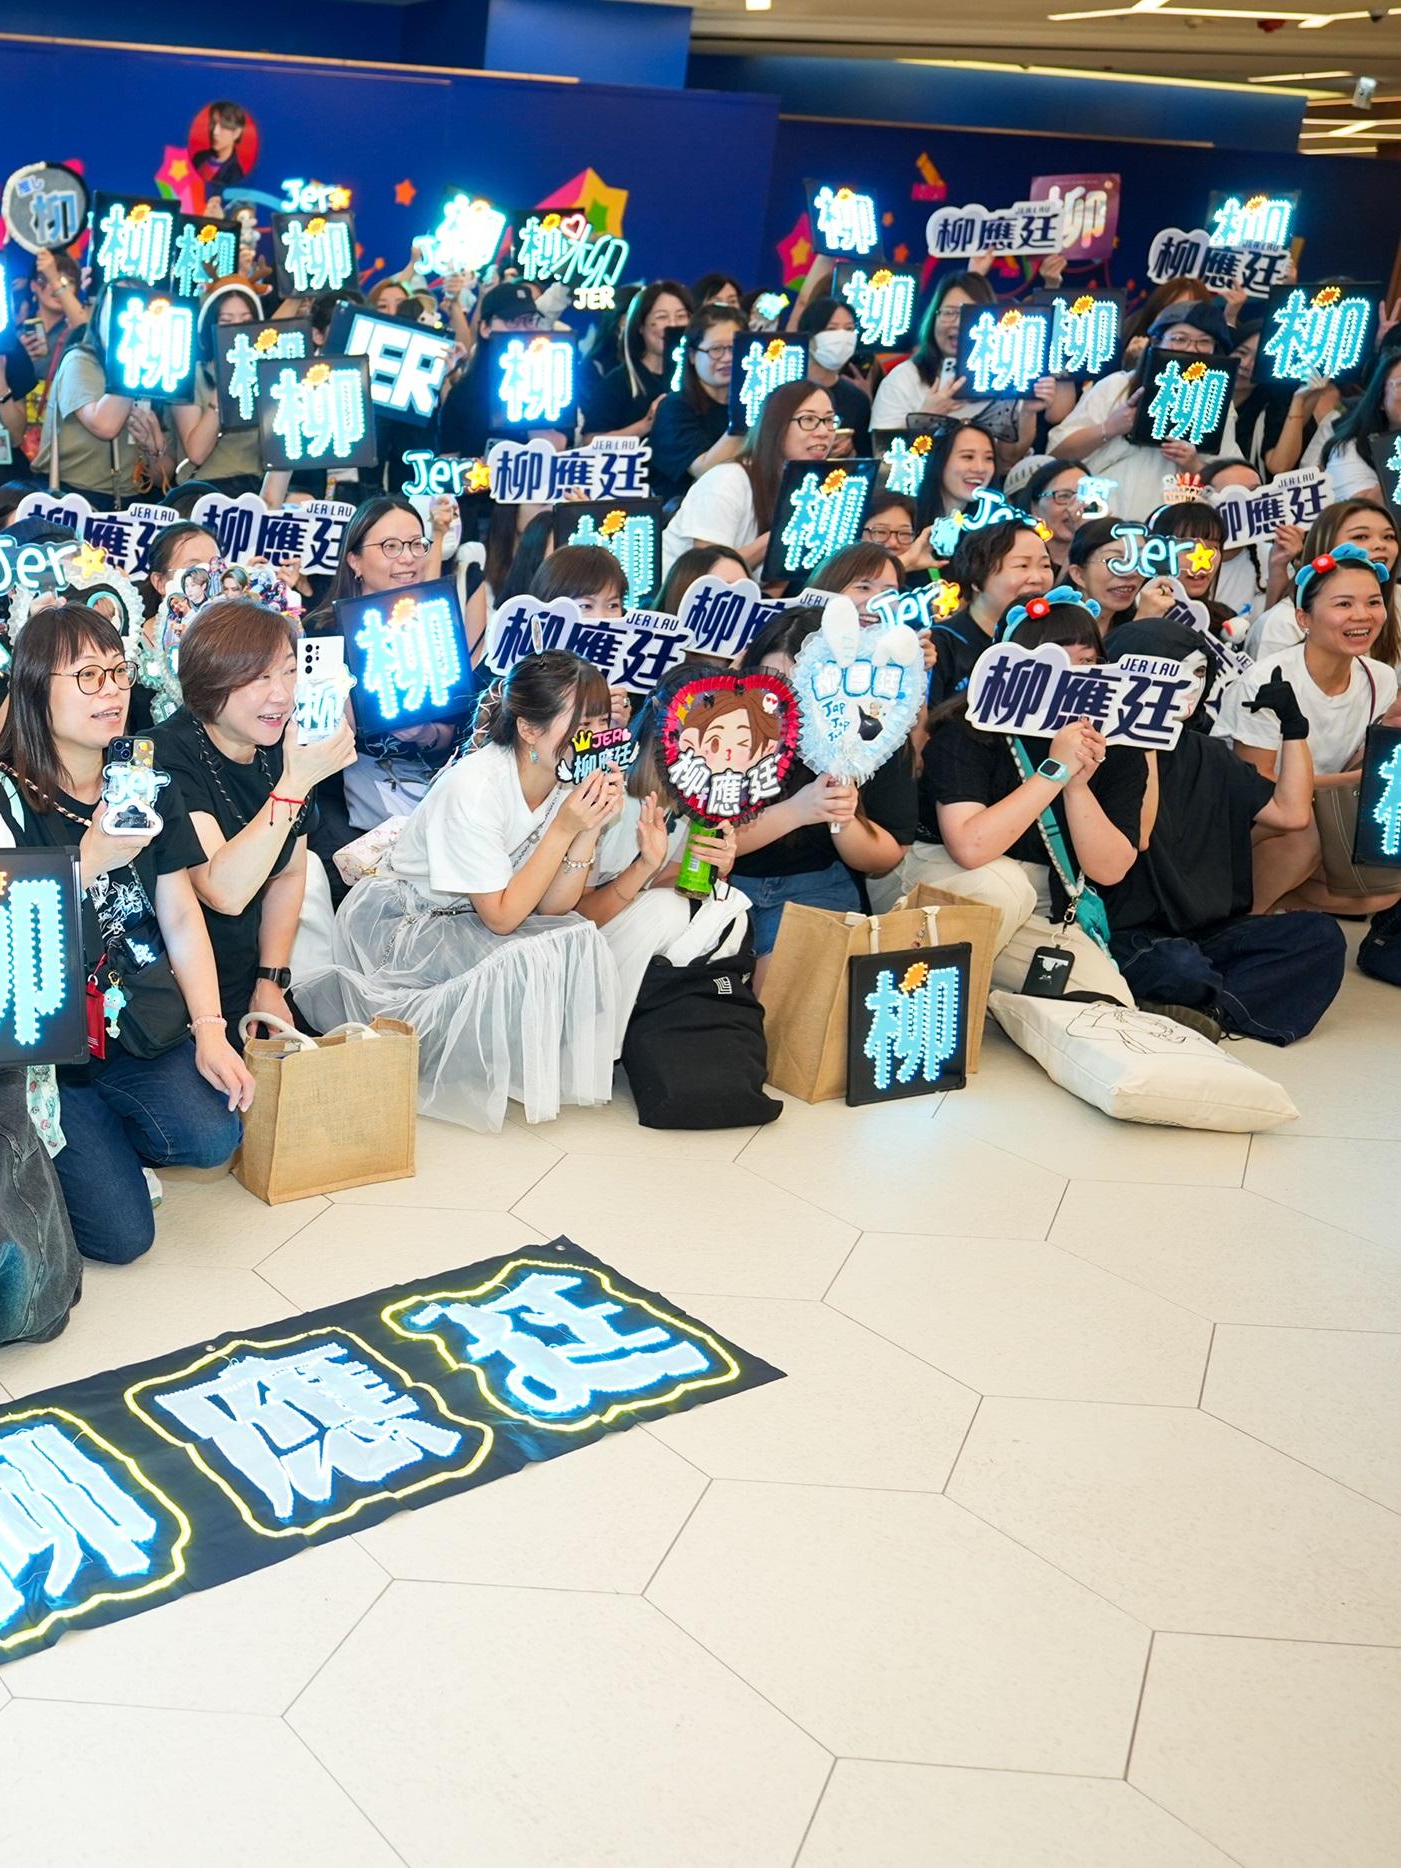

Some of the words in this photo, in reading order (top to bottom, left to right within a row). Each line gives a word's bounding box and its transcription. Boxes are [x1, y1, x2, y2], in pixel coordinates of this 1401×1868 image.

[98, 203, 172, 287] 柳
[813, 185, 878, 254] 柳
[936, 212, 1059, 253] 柳應廷
[282, 220, 353, 292] 柳
[1153, 236, 1287, 297] 柳應廷
[574, 287, 616, 310] JER
[843, 269, 915, 347] 柳
[116, 297, 193, 393] 柳
[966, 311, 1048, 393] 柳
[1263, 288, 1372, 380] 柳
[270, 368, 365, 461] 柳
[499, 339, 575, 423] 柳
[1148, 359, 1230, 445] 柳
[402, 450, 467, 496] Jer
[498, 450, 645, 501] 柳應廷
[593, 440, 614, 450] JER
[617, 440, 636, 450] LAU
[130, 506, 151, 519] JER
[153, 509, 176, 522] LAU
[306, 501, 327, 515] JER
[330, 504, 353, 518] LAU
[1278, 475, 1297, 489] JER
[1299, 472, 1315, 483] LAU
[202, 502, 349, 571] 柳應廷
[781, 472, 870, 572] 柳
[1109, 525, 1193, 574] Jer
[626, 611, 651, 626] JER
[652, 616, 680, 633] LAU
[869, 583, 940, 628] Jer
[355, 597, 462, 720] 柳
[1120, 658, 1149, 673] JER
[1151, 661, 1180, 677] LAU
[1236, 654, 1253, 668] JE
[972, 655, 1192, 744] 柳應廷
[592, 728, 623, 748] JER
[668, 747, 782, 815] 柳應廷
[863, 964, 961, 1090] 柳
